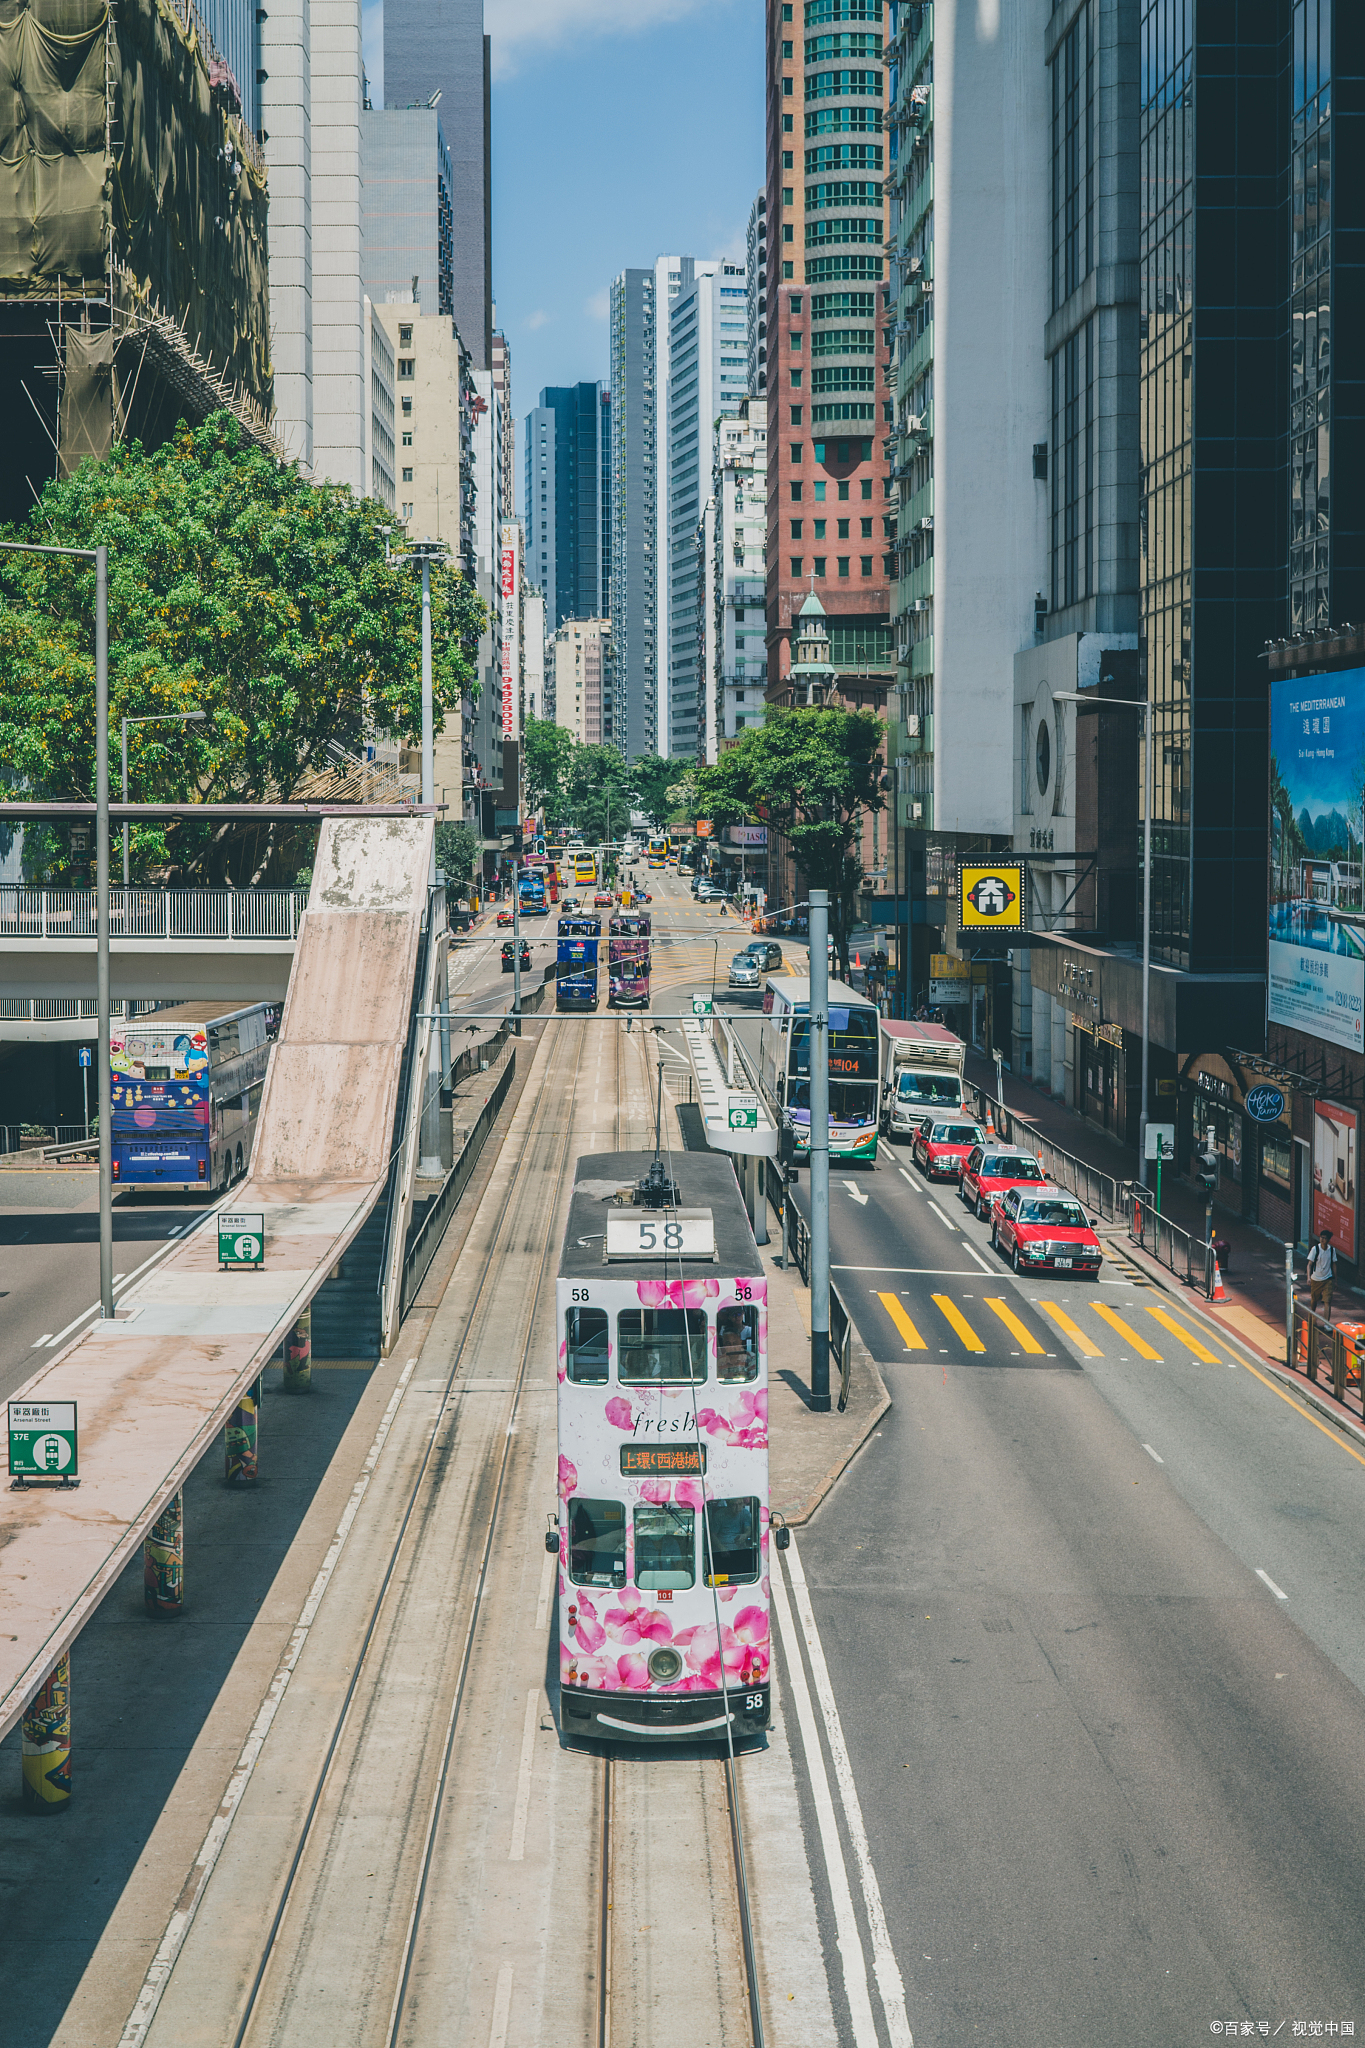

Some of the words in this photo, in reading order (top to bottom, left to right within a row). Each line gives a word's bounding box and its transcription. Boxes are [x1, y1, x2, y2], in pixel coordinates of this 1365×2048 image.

[1289, 702, 1300, 713] THE
[1300, 696, 1346, 712] MEDITERRANEAN
[841, 1060, 859, 1072] 104
[639, 1223, 684, 1250] 58
[571, 1288, 590, 1301] 58
[734, 1287, 752, 1301] 58
[632, 1411, 696, 1437] fresh
[13, 1433, 30, 1441] 37E
[658, 1592, 672, 1600] 101
[745, 1694, 763, 1710] 58
